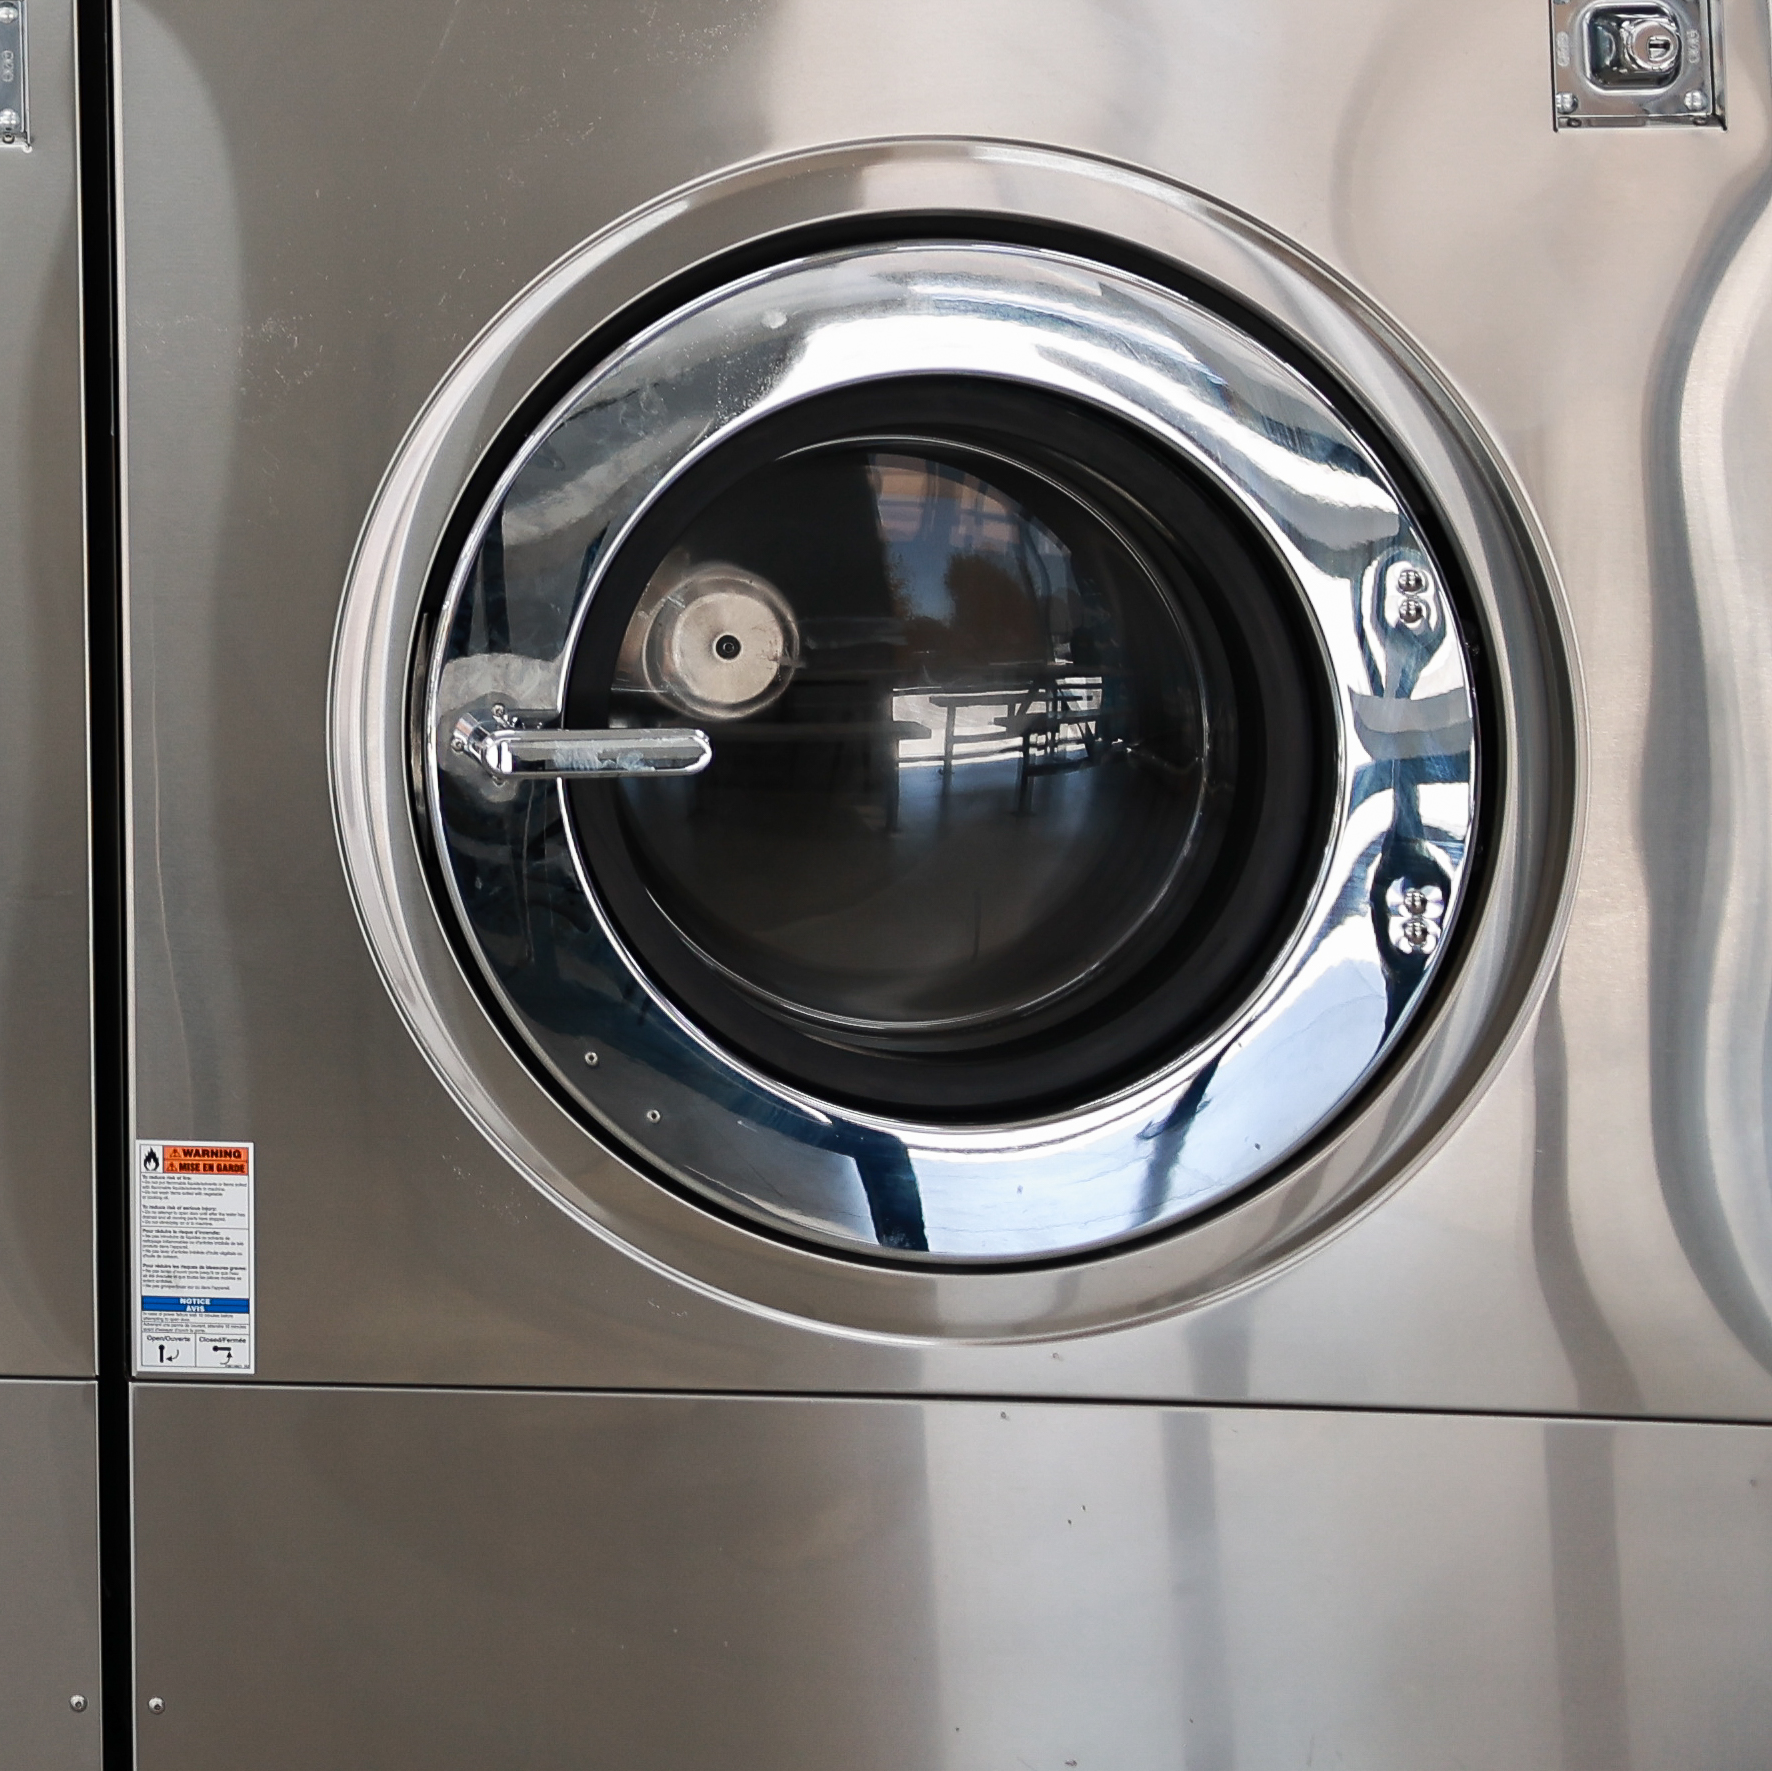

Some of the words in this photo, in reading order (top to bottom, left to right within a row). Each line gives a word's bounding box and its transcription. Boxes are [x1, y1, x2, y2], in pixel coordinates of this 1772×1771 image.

[182, 1148, 242, 1159] WARNING
[178, 1162, 200, 1172] MISE
[202, 1163, 214, 1172] EN
[216, 1163, 245, 1173] GARDE
[179, 1297, 211, 1305] NOTICE
